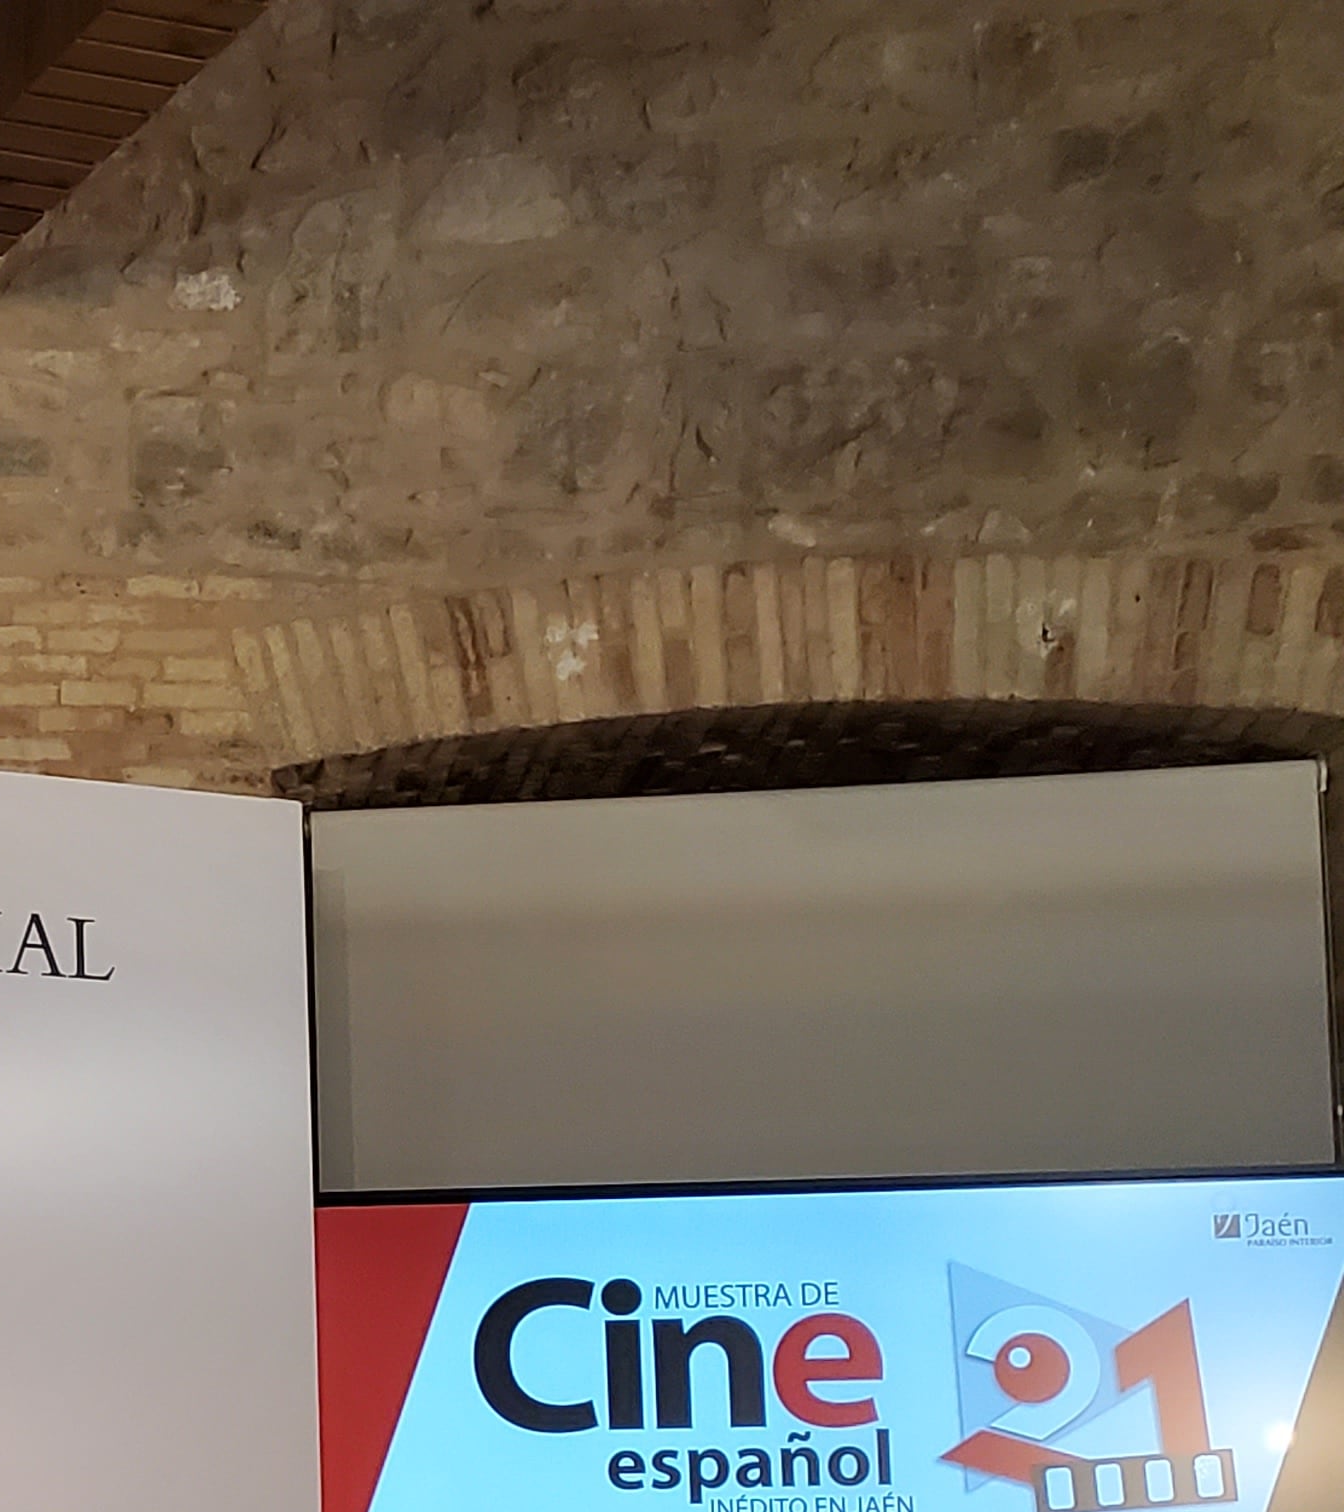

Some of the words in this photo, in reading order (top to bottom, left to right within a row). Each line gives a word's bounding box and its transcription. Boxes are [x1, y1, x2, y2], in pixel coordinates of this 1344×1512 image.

[1245, 1212, 1308, 1238] Jaén
[655, 1283, 791, 1309] MUESTRA
[801, 1282, 840, 1306] DE
[474, 1277, 885, 1433] Cine
[608, 1429, 892, 1504] español
